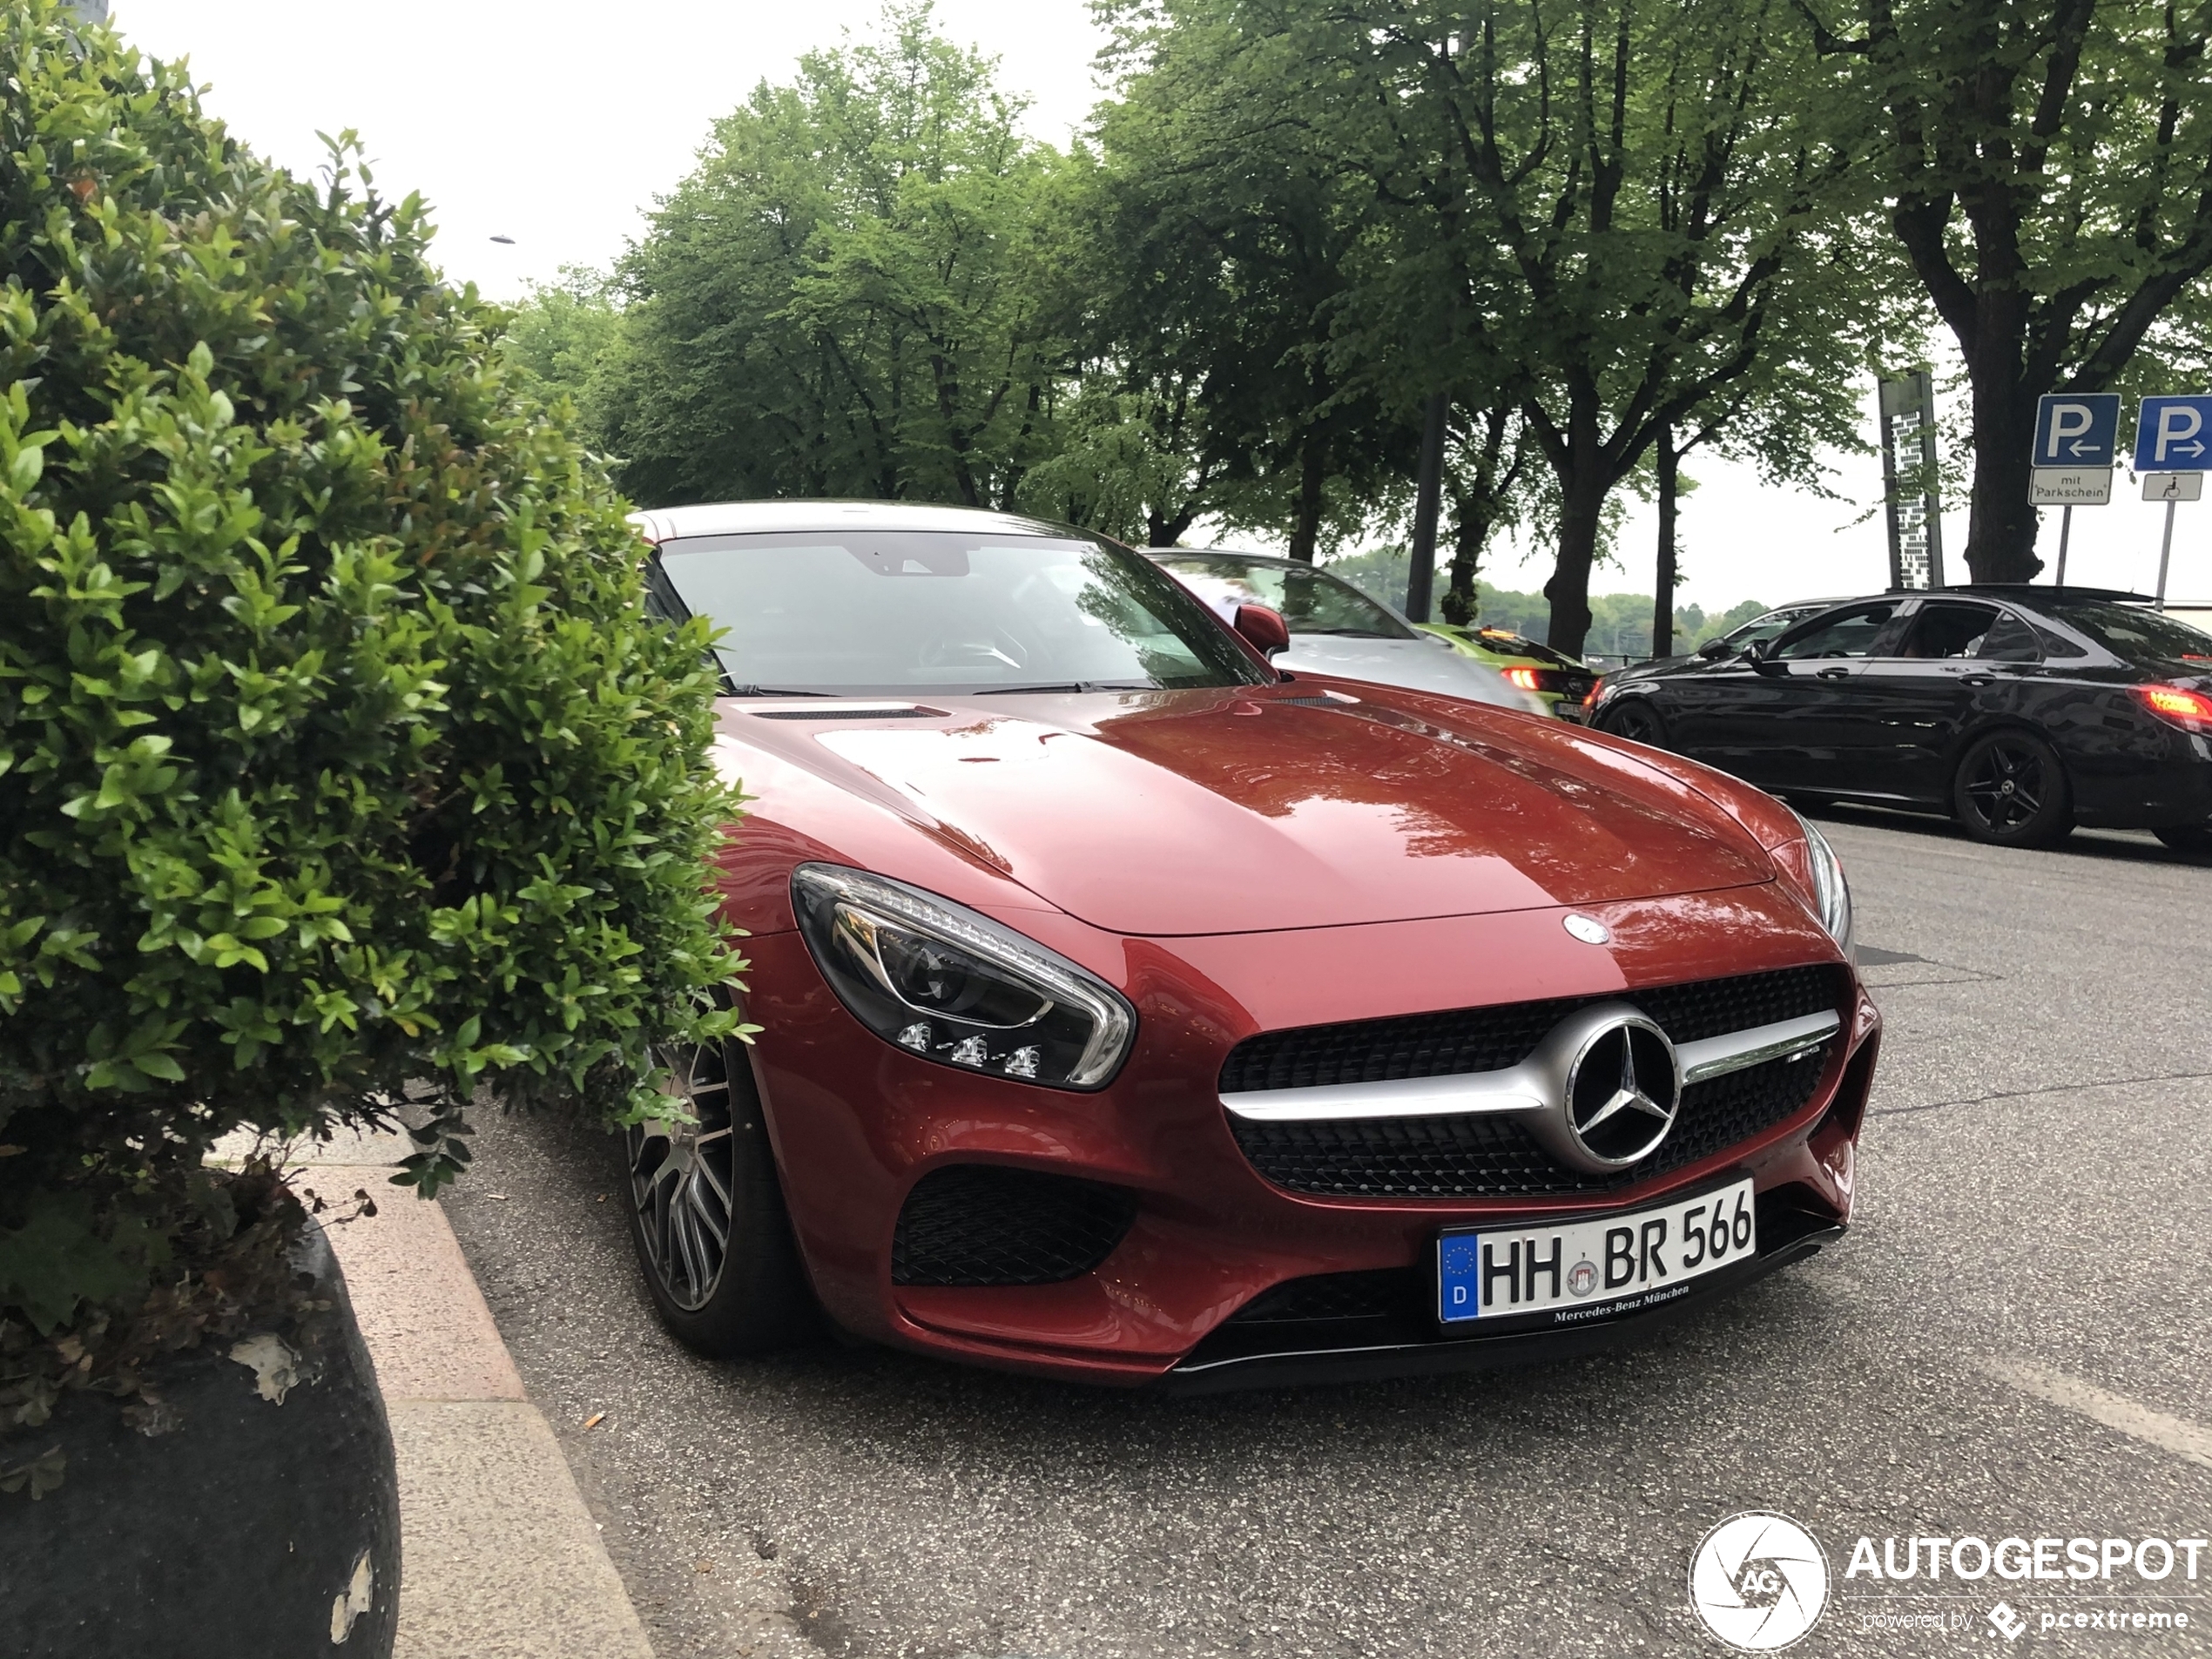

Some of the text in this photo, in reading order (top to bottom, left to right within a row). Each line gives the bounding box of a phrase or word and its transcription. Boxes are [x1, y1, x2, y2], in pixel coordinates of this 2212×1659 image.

[2047, 404, 2093, 457] P
[2155, 406, 2202, 462] P
[2036, 487, 2104, 497] Parkschein
[2060, 475, 2081, 485] mit
[1483, 1190, 1752, 1306] HH BR 566
[1453, 1285, 1467, 1305] D
[1554, 1284, 1689, 1323] Mercedes-Benz München
